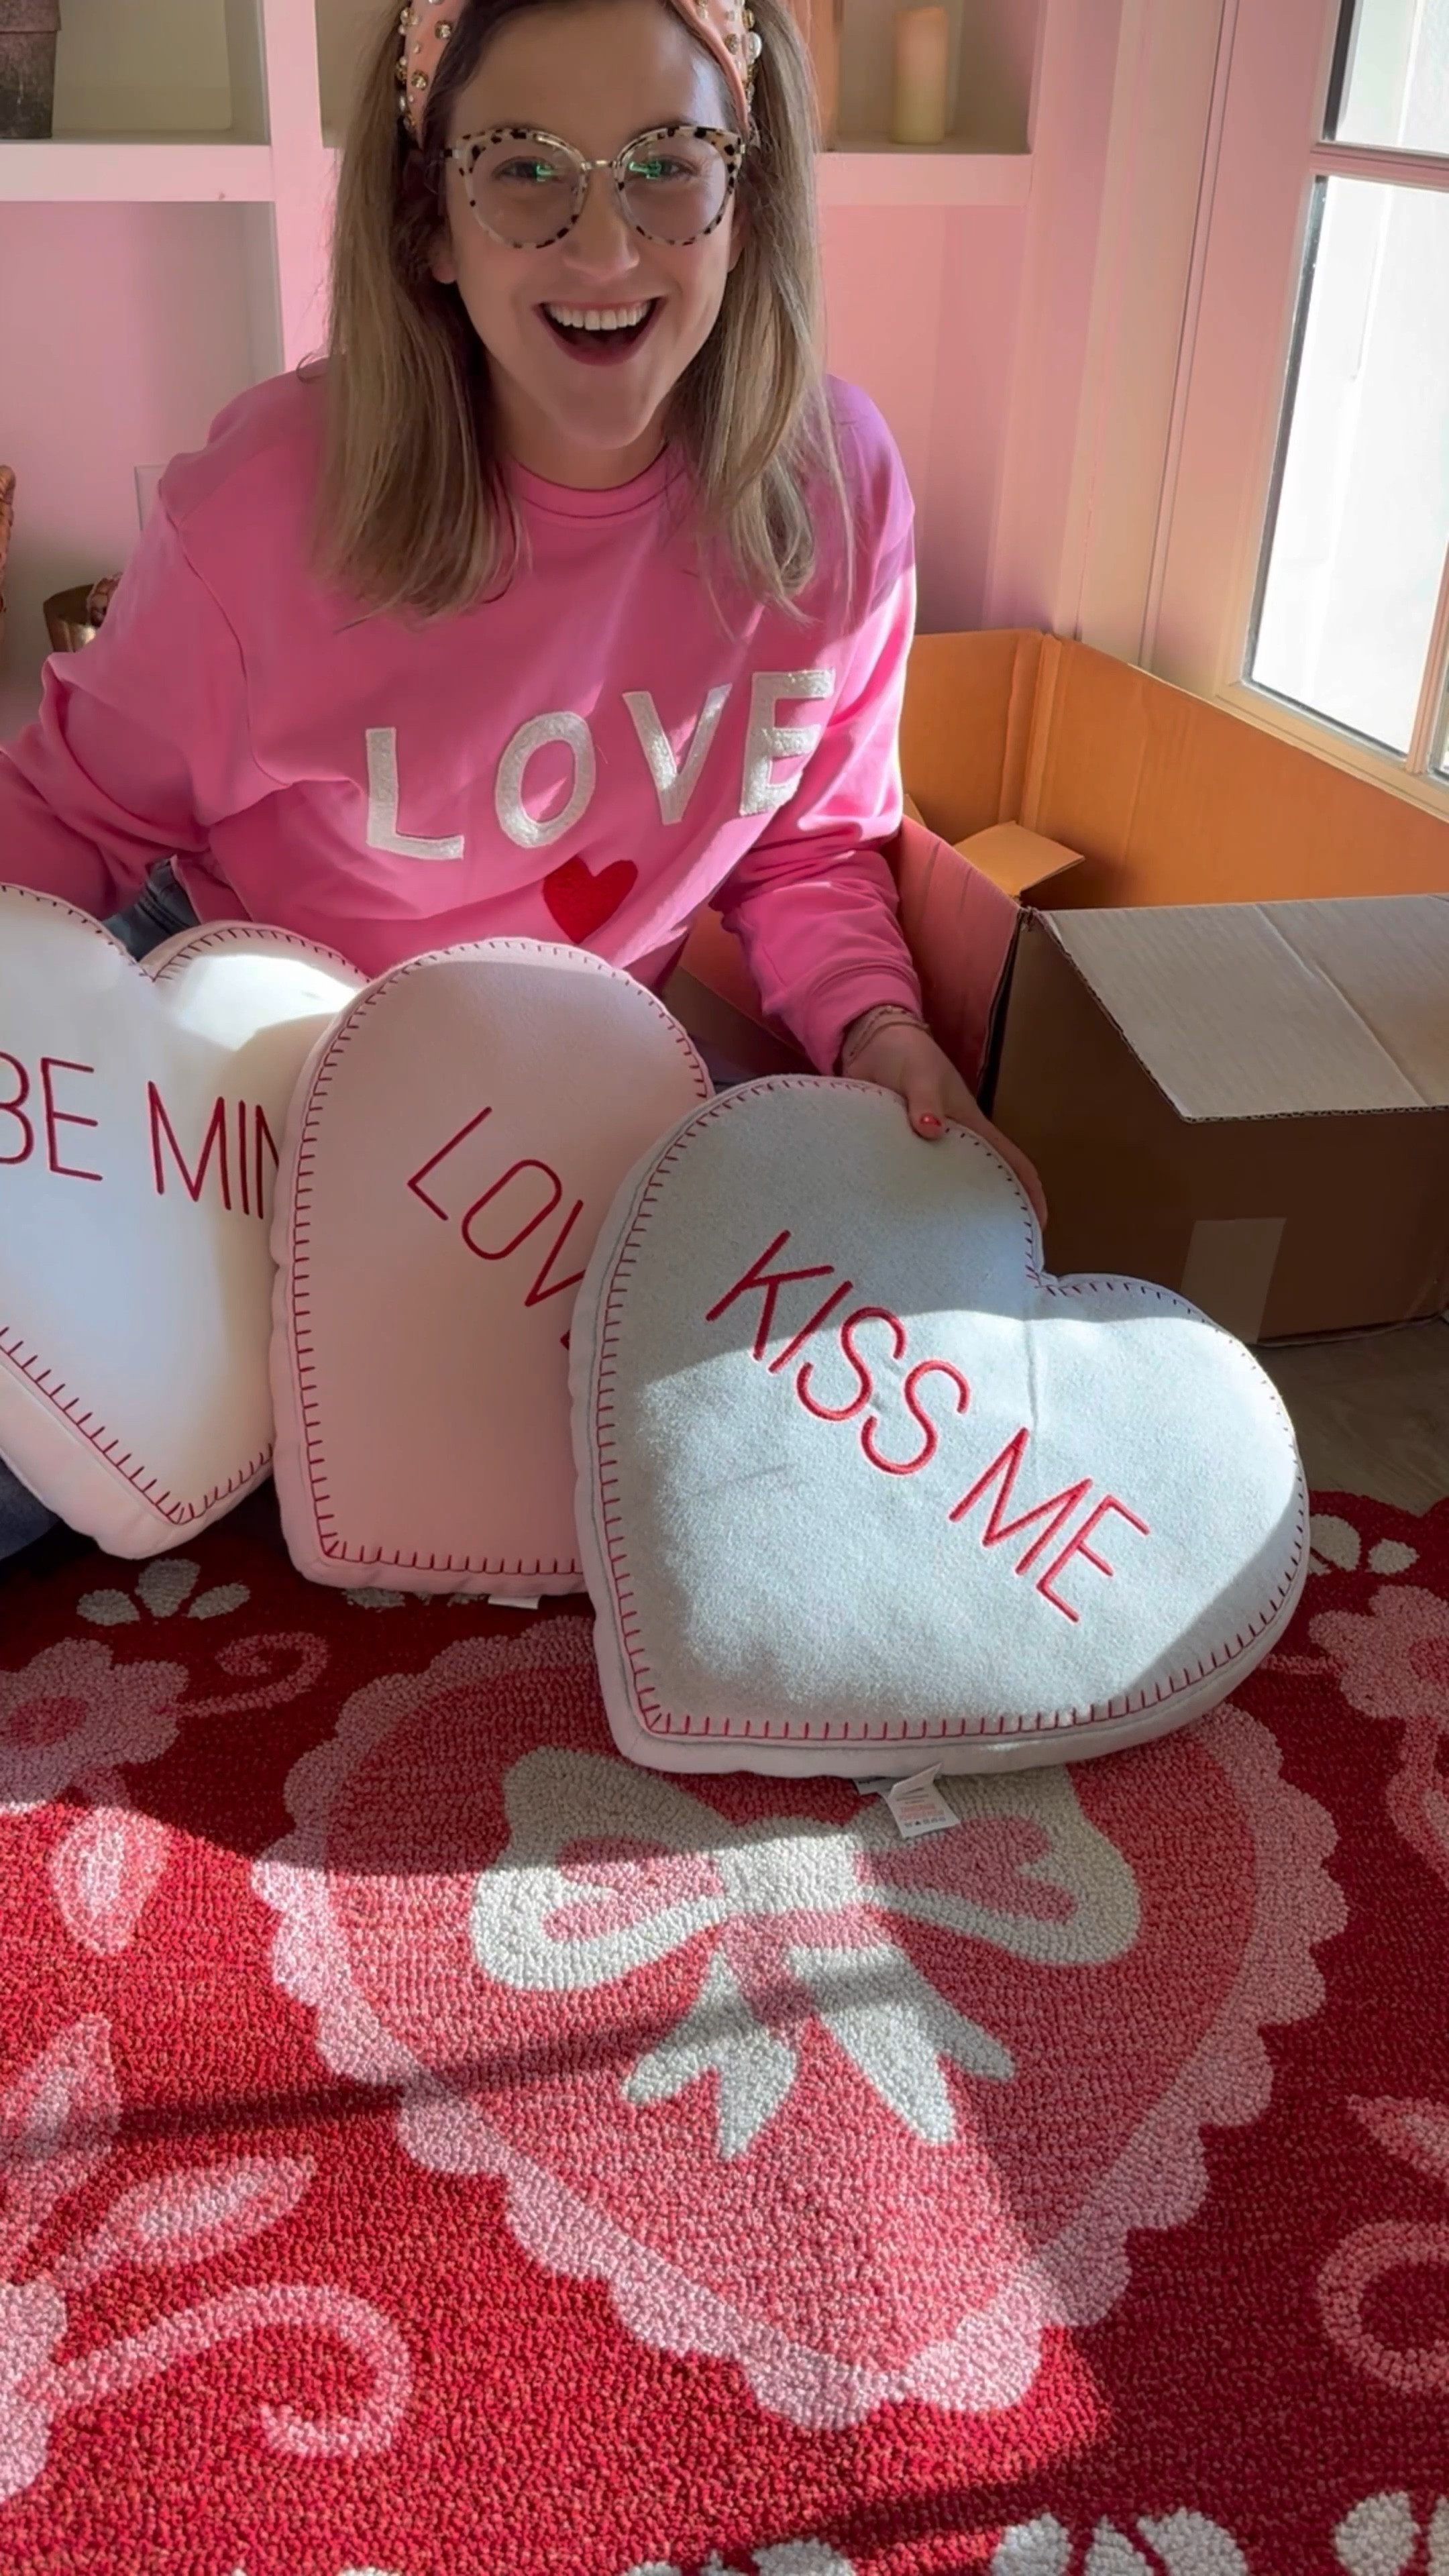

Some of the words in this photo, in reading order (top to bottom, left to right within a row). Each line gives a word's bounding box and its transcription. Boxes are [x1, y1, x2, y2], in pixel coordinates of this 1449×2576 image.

[366, 667, 835, 861] LOVE
[0, 1051, 103, 1181] BE
[407, 1106, 586, 1350] LOV
[705, 1230, 971, 1475] KISS
[949, 1427, 1150, 1623] ME
